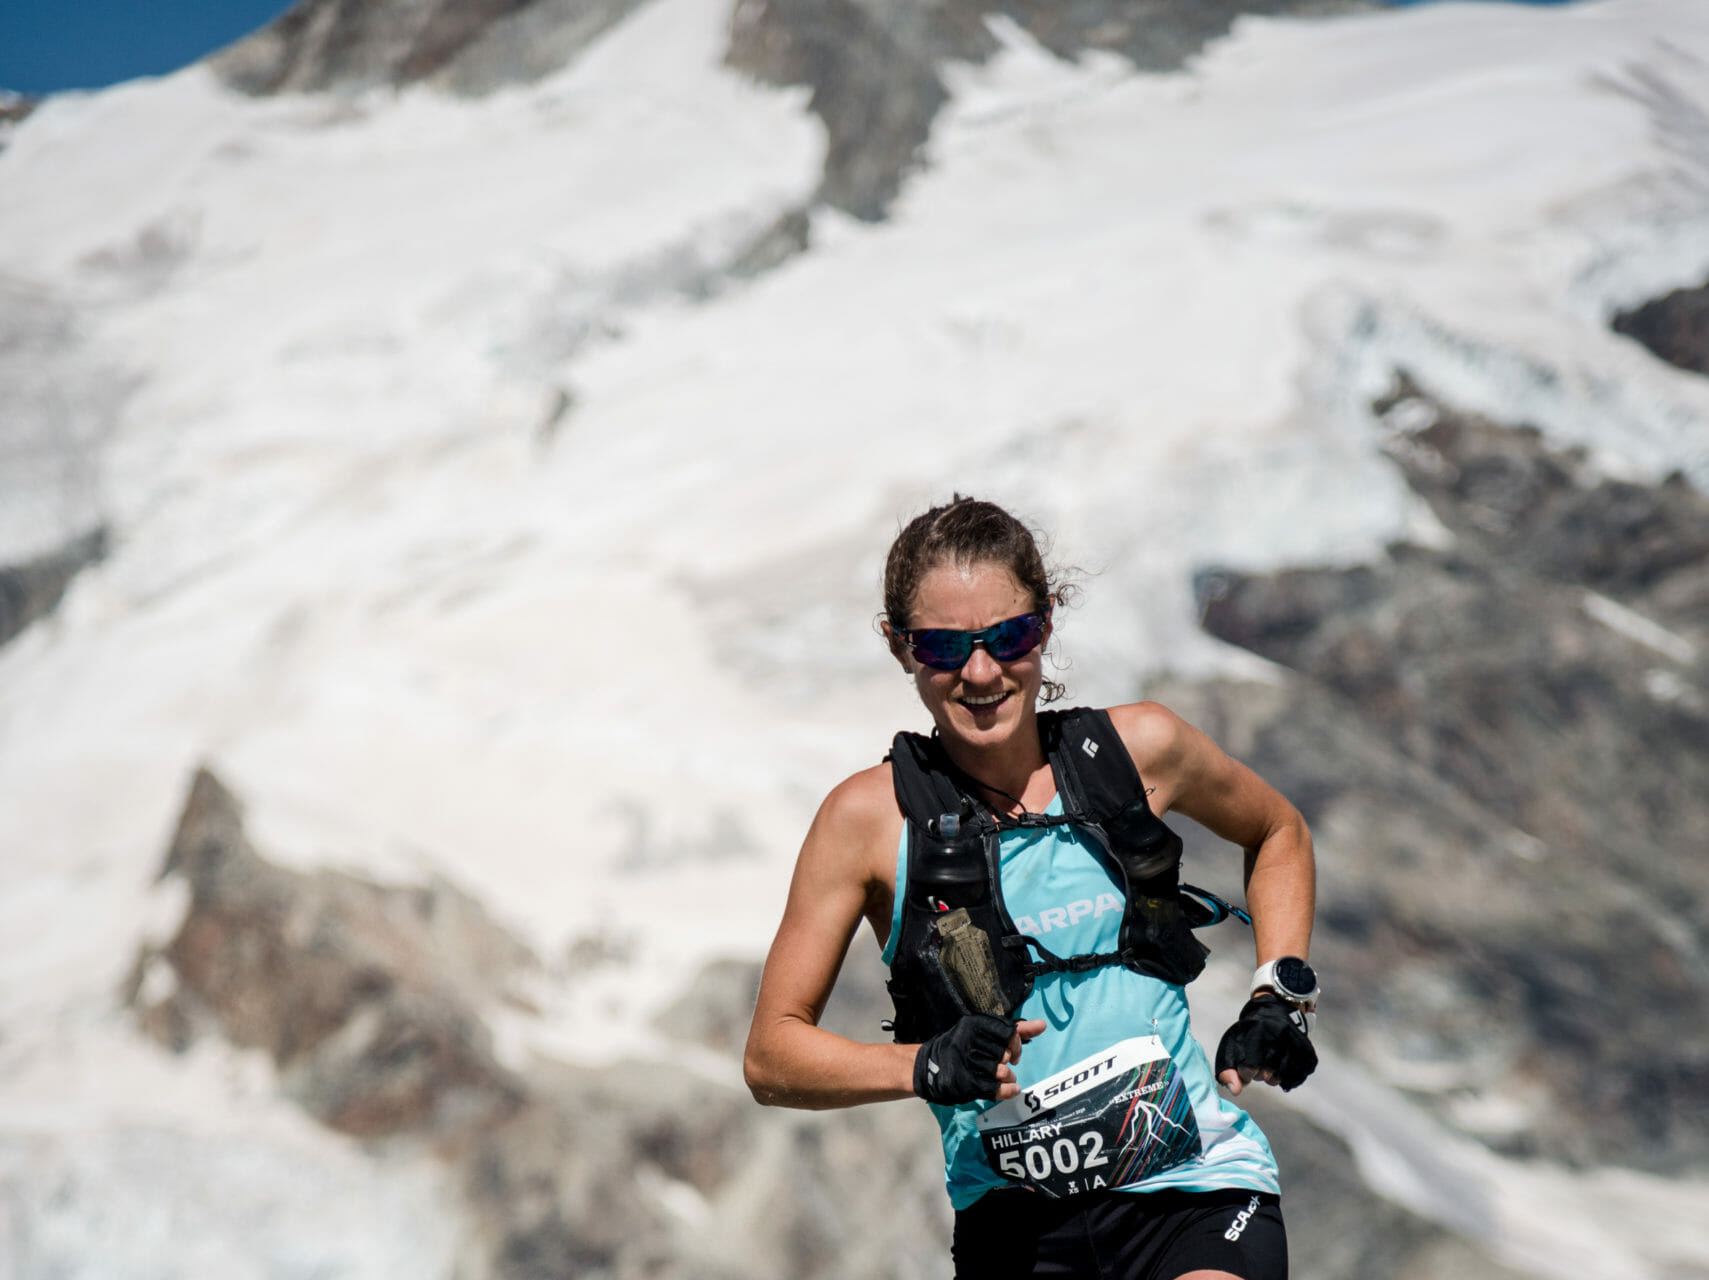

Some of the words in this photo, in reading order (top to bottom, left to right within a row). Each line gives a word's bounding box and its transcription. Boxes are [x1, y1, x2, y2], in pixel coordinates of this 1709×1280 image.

[1043, 1055, 1118, 1101] SCOTT
[991, 1121, 1064, 1150] HILLARY
[999, 1130, 1109, 1182] 5002
